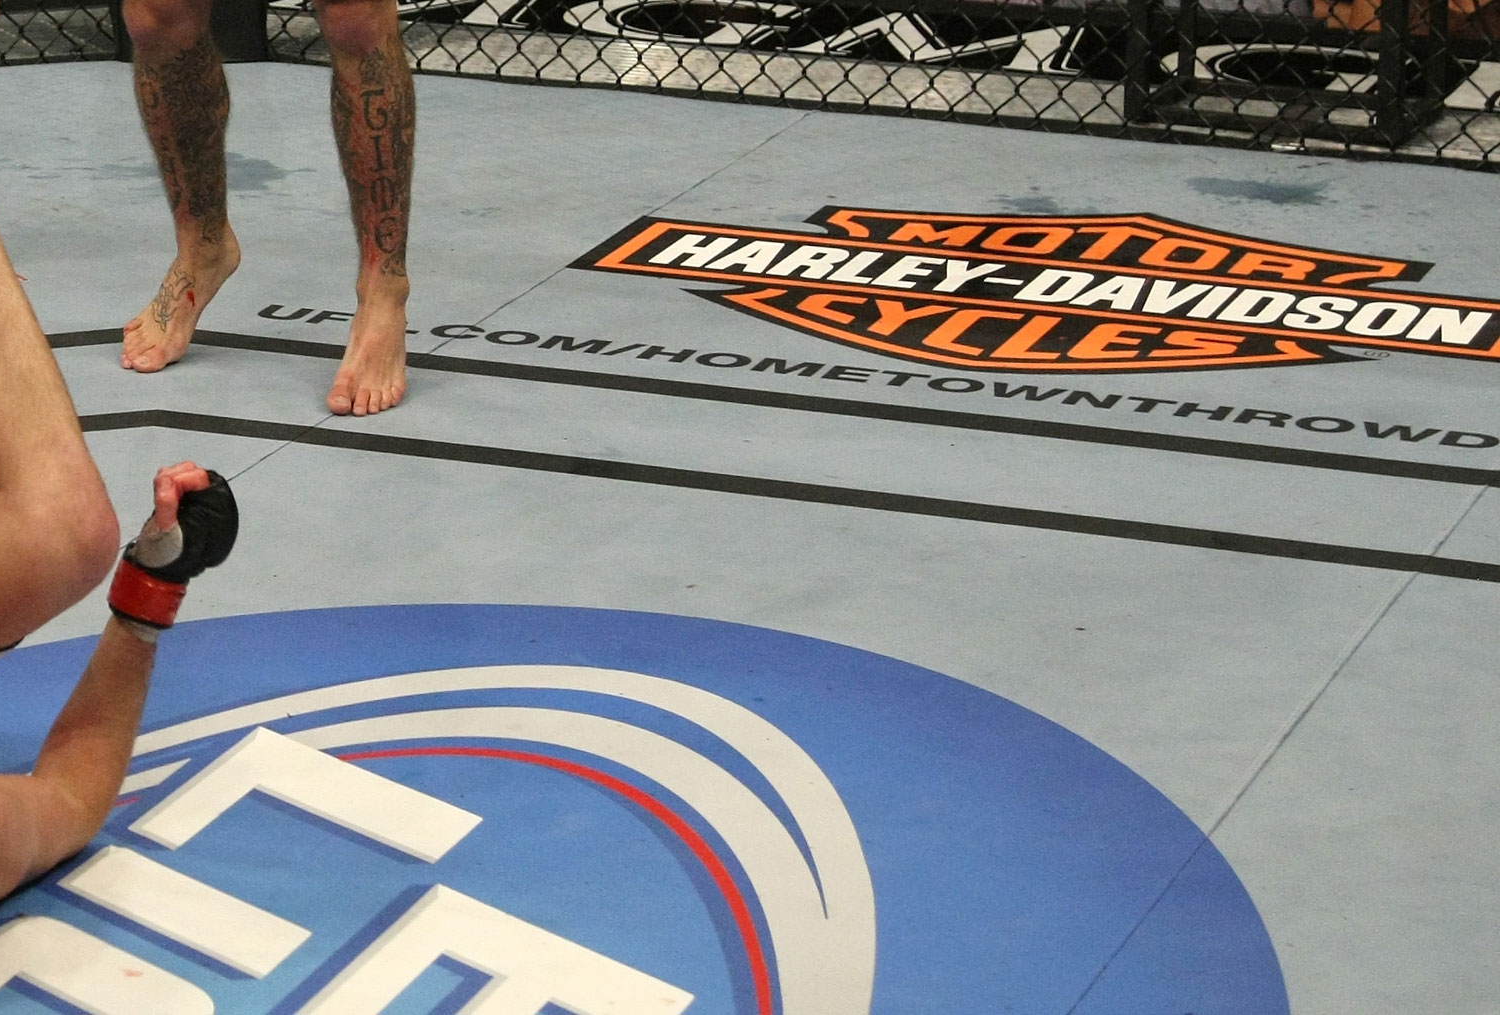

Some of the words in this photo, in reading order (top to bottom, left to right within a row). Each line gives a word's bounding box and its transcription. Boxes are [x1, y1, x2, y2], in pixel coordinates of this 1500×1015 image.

[887, 223, 1317, 282] MOTOR
[648, 233, 1492, 345] HARLEY-DAVIDSON
[796, 291, 1248, 360] CYCLES
